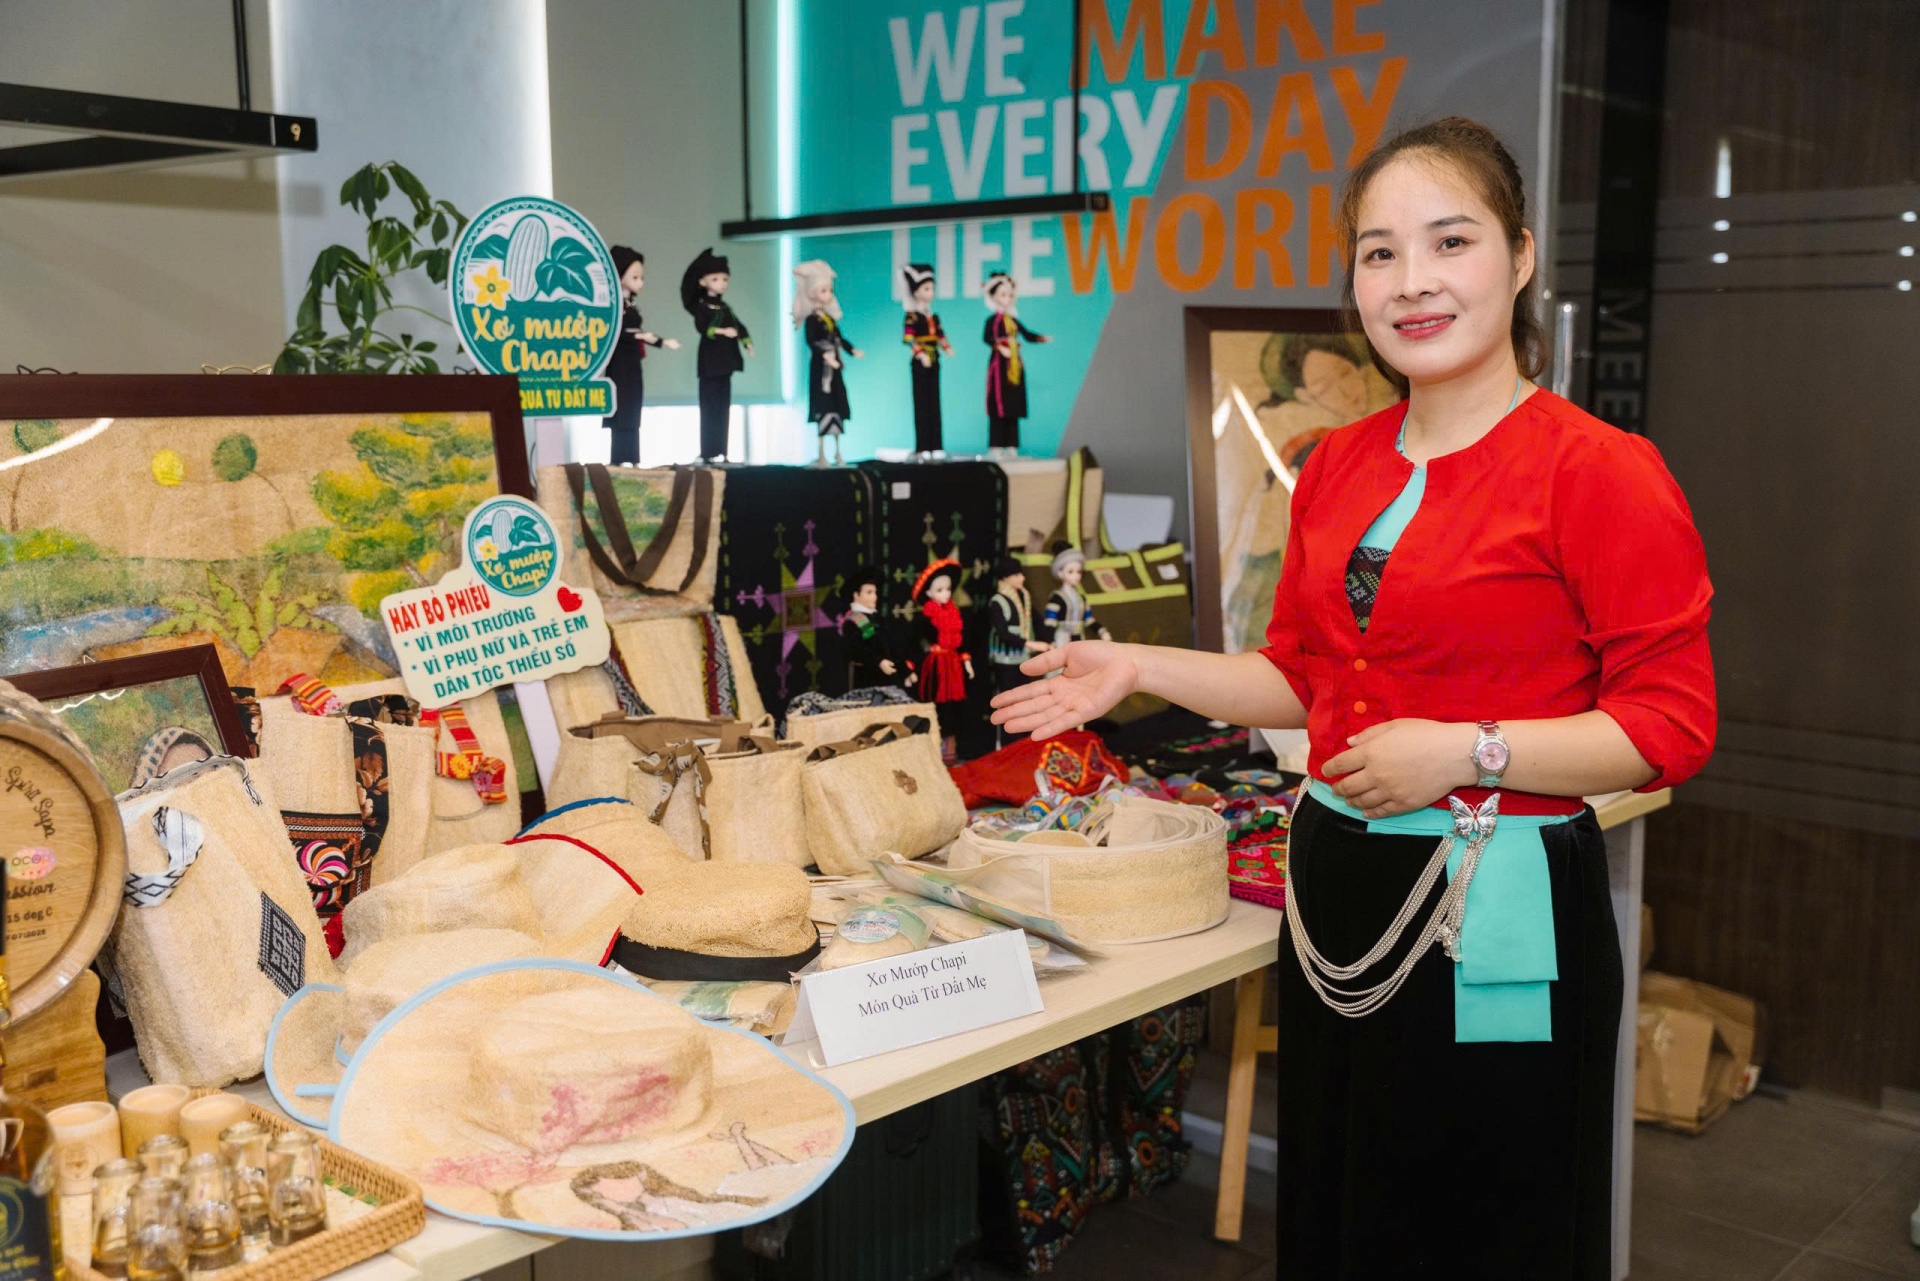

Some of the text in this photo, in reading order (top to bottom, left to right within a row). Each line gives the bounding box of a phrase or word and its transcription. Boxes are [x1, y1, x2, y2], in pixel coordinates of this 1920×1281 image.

[888, 0, 1386, 107] WE MAKE
[891, 57, 1408, 203] EVERY DAY
[471, 307, 515, 342] Xơ
[501, 339, 593, 382] Chapi
[501, 564, 549, 589] Chapi
[415, 606, 536, 652] VÌ MÔI TRƯỜNG
[423, 615, 589, 676] VÌ PHỤ NỮ VÀ TRẺ EM
[434, 675, 470, 699] DÂN
[472, 663, 505, 687] TỘC
[555, 637, 577, 661] SỐ
[866, 951, 968, 988] Xơ Mướp Chapi
[858, 974, 987, 1018] Món Quà Từ Đất Mẹ
